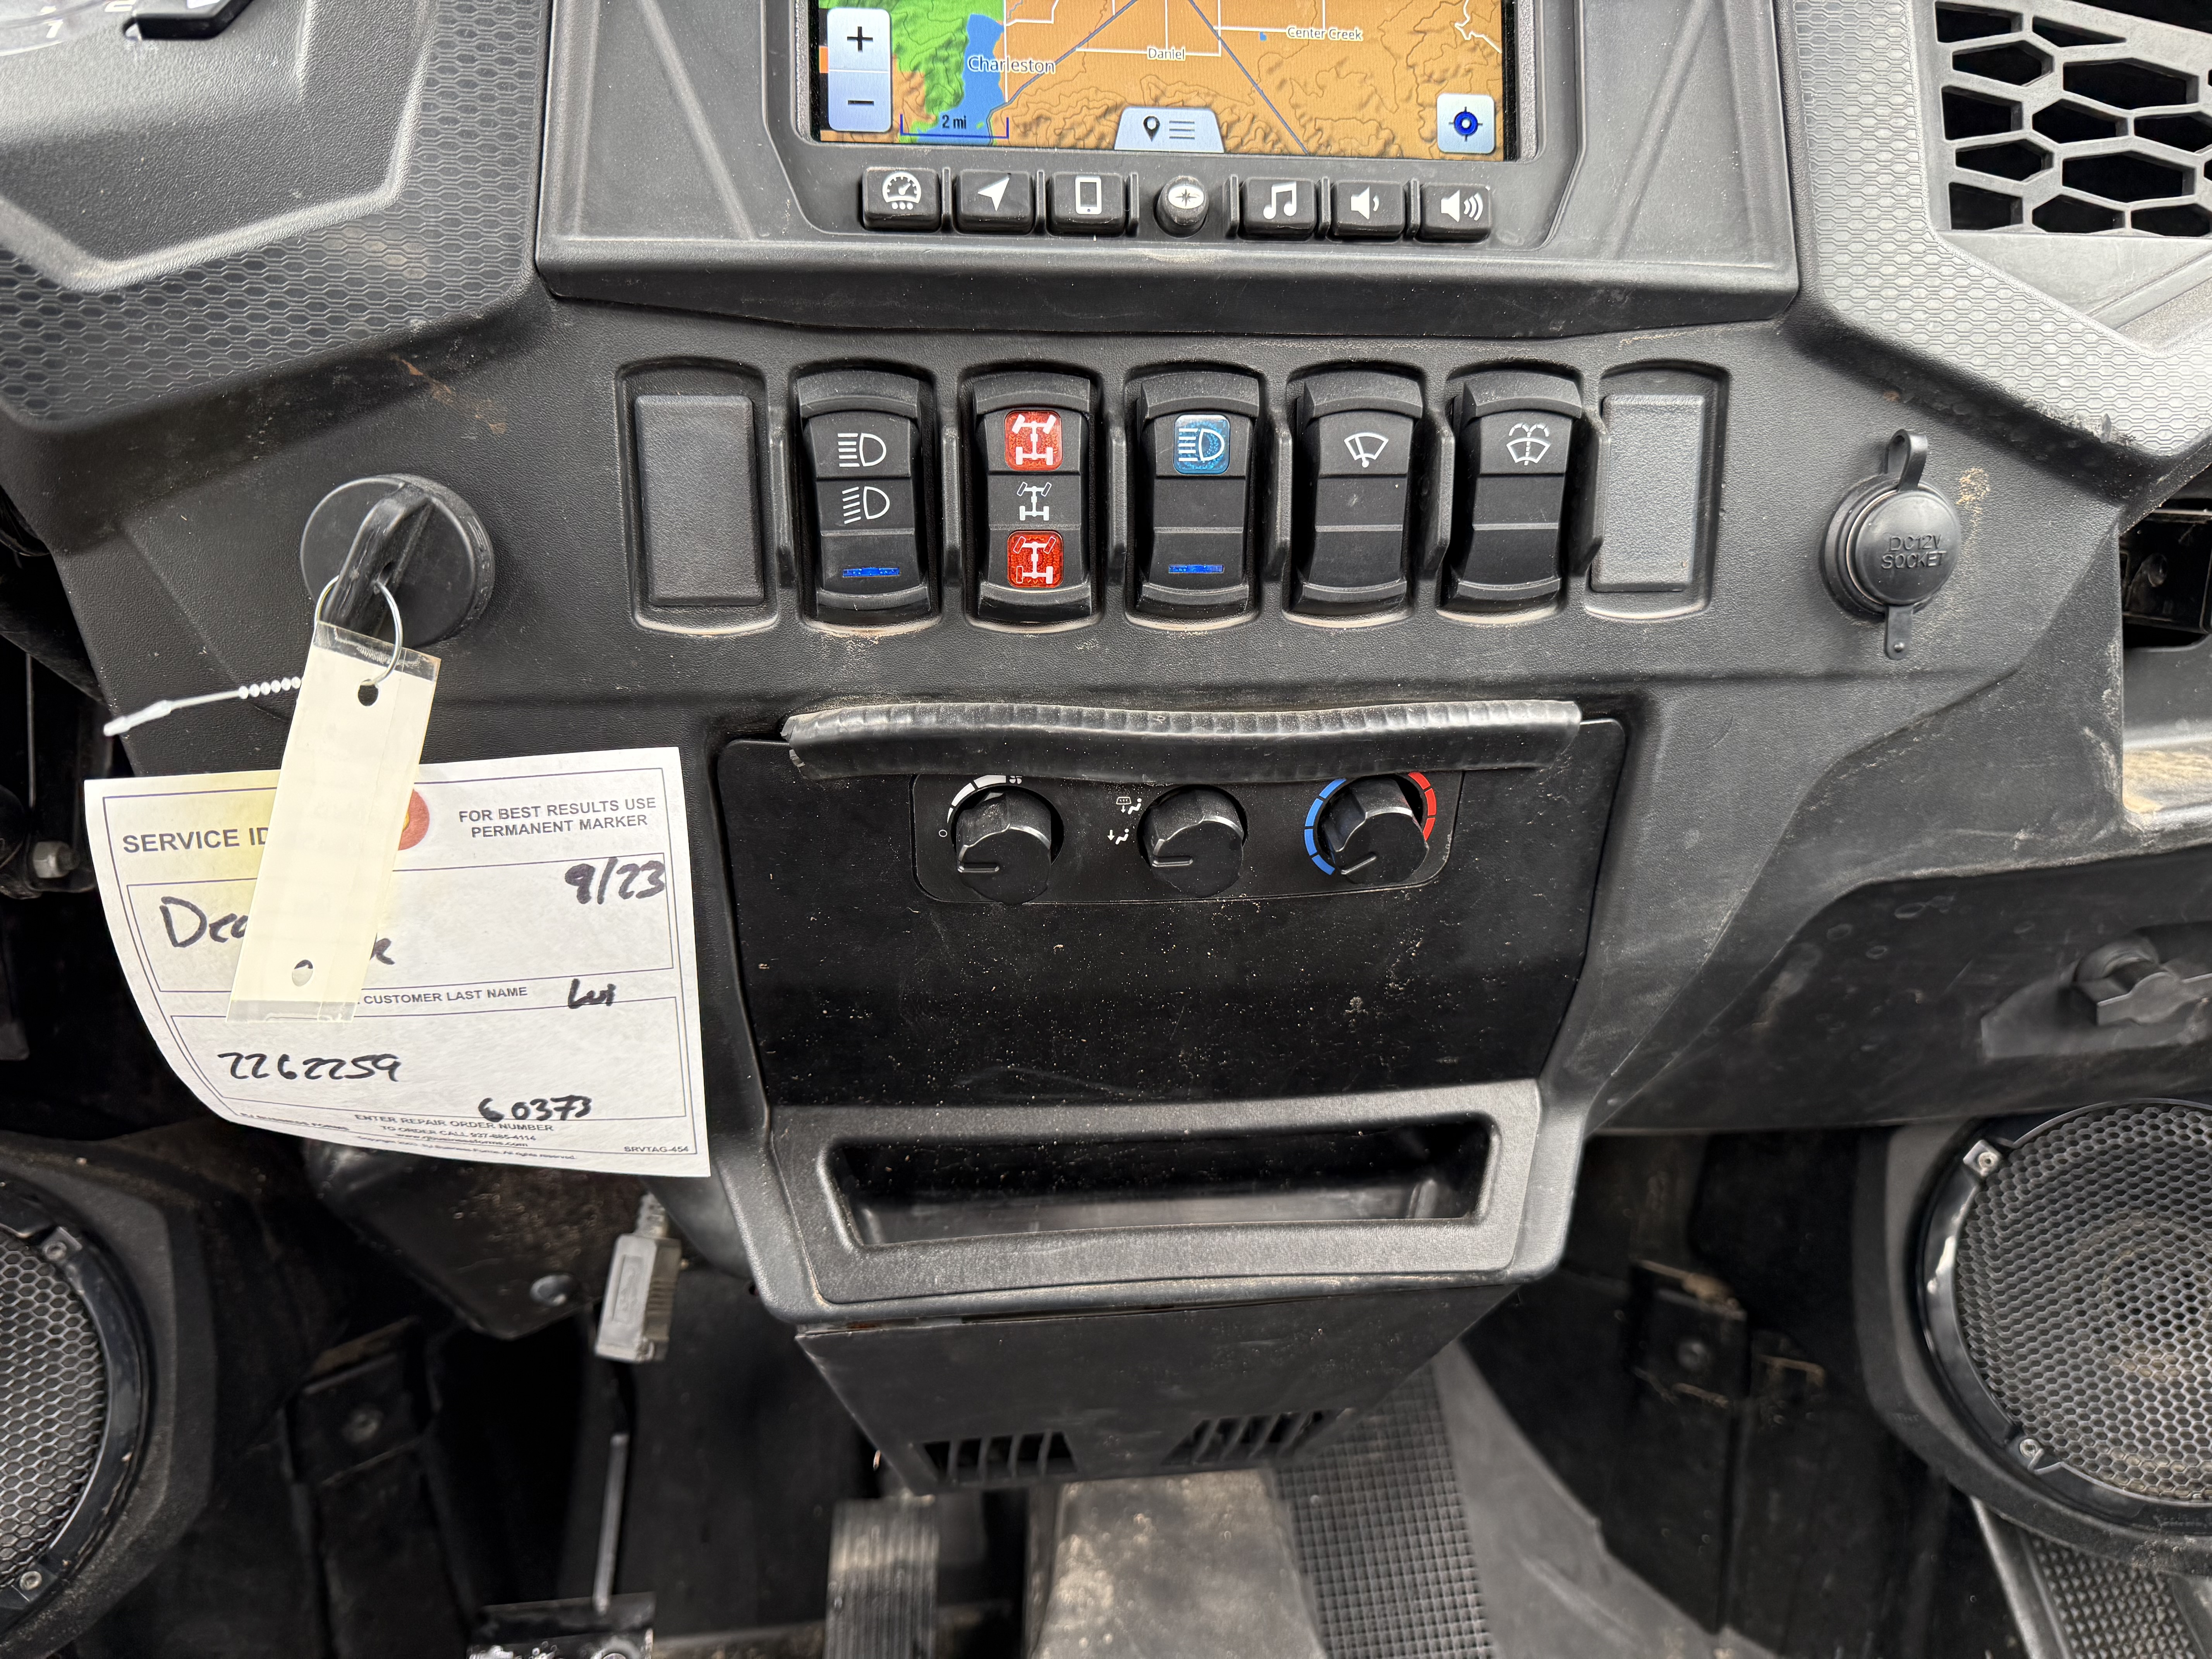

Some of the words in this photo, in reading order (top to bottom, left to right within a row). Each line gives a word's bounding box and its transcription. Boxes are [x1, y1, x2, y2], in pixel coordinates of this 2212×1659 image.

[1287, 27, 1326, 39] Center
[1329, 28, 1362, 40] Creek
[1148, 48, 1185, 60] Daniel
[968, 56, 1055, 74] Charleston
[942, 115, 950, 129] 2
[953, 115, 967, 129] mi
[1889, 534, 1942, 551] DC12V
[1881, 550, 1947, 569] SOCKET
[460, 809, 493, 823] FOR
[498, 805, 541, 820] BEST
[547, 800, 620, 816] RESULTS
[625, 797, 656, 811] USE
[471, 819, 574, 838] PERMANENT
[579, 814, 648, 830] MARKER
[122, 828, 240, 853] SERVICE
[565, 856, 666, 905] 9/23
[364, 993, 443, 1005] CUSTOMER
[447, 989, 483, 1001] LAST
[487, 986, 528, 999] NAME
[217, 1052, 402, 1082] 2262259
[355, 1114, 398, 1123] ENTER
[401, 1117, 447, 1127] REPAIR
[450, 1120, 496, 1130] ORDER
[499, 1123, 554, 1132] NUMBER
